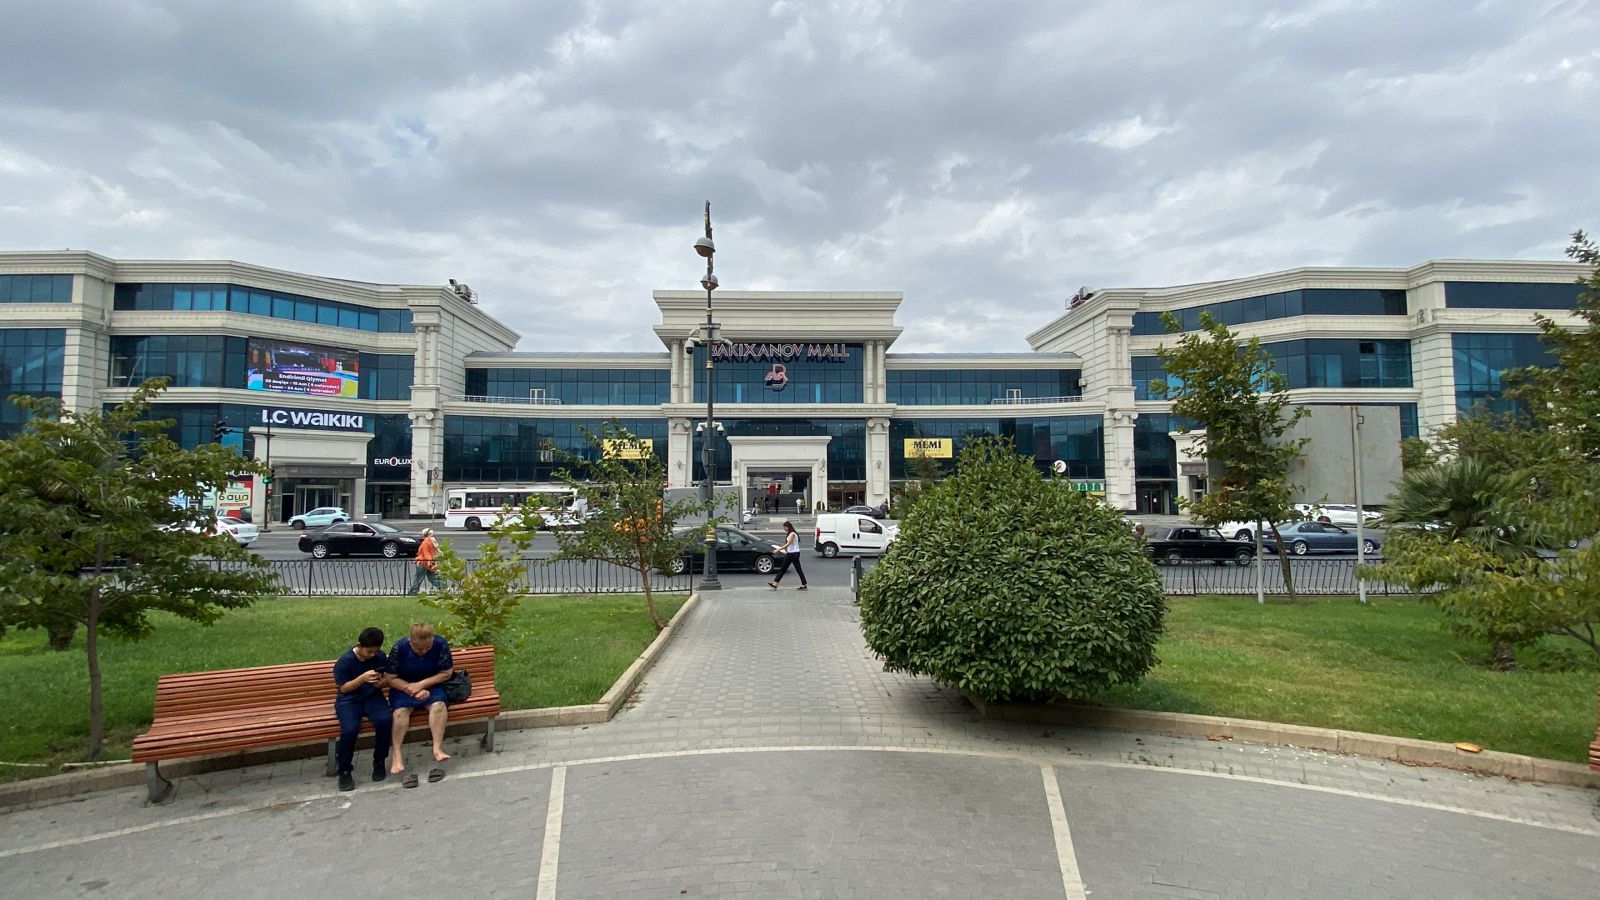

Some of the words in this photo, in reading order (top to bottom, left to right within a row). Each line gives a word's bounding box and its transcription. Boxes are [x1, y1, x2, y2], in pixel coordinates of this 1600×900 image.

[807, 343, 850, 357] MALL
[261, 409, 288, 424] LC
[913, 440, 942, 449] MEMI
[374, 456, 412, 467] EUROLUX
